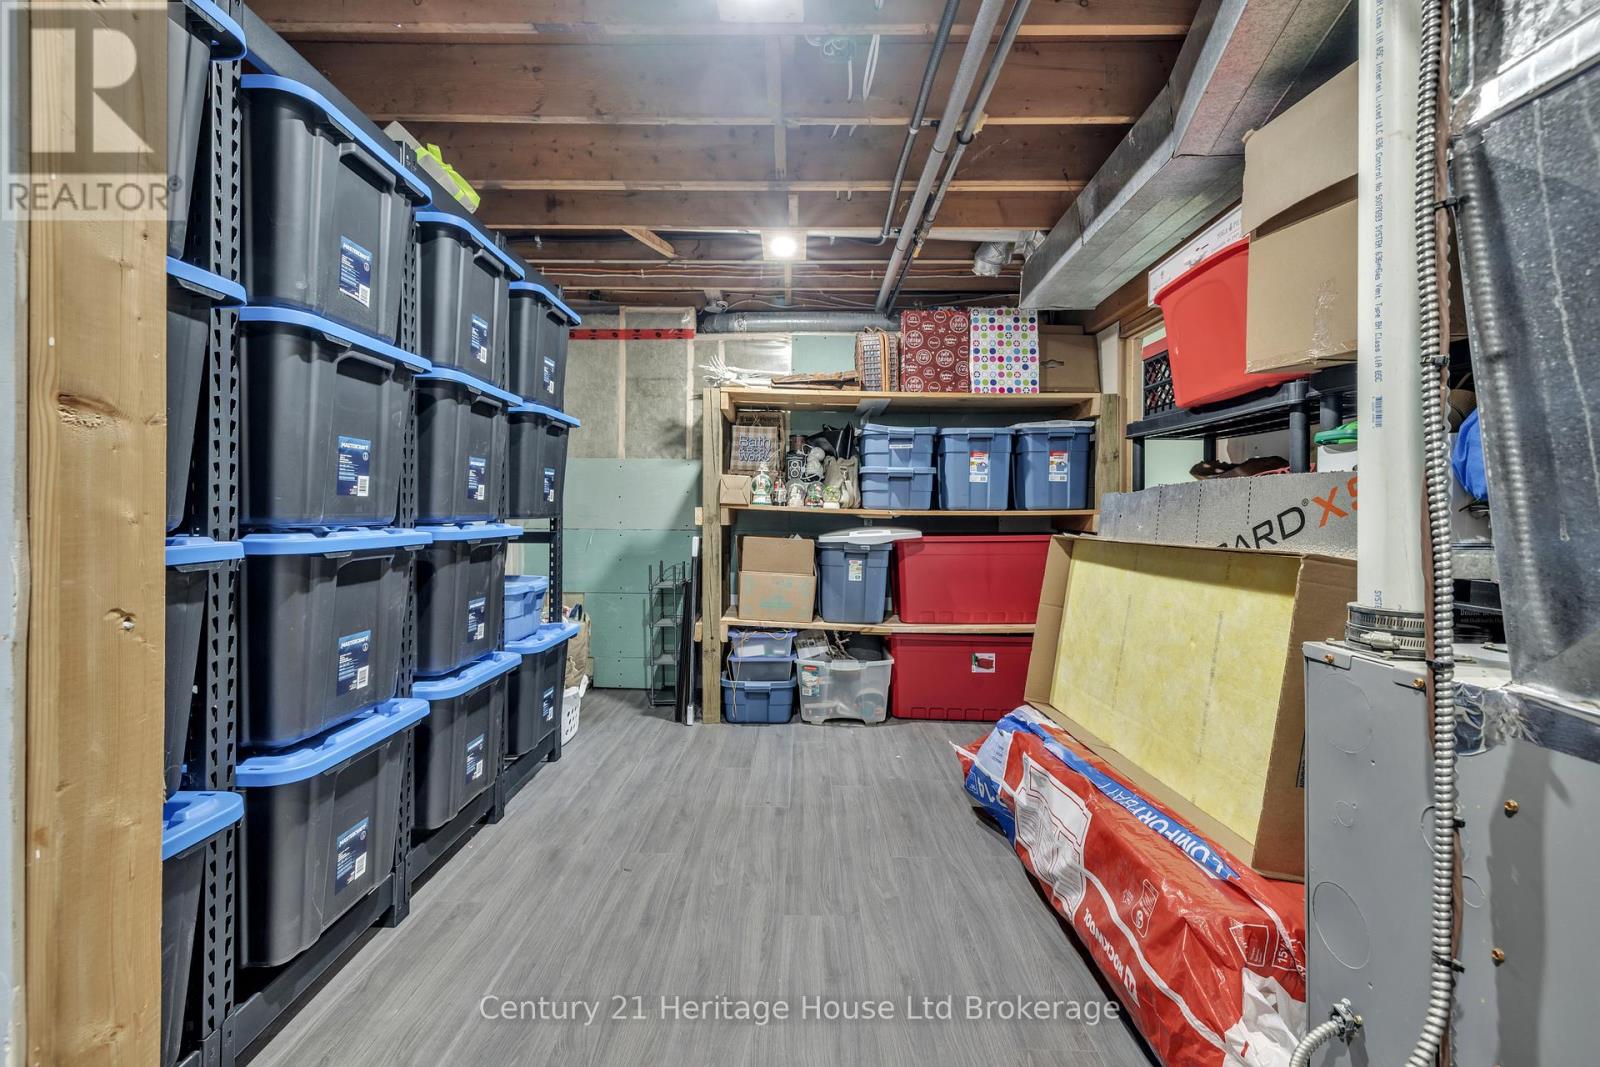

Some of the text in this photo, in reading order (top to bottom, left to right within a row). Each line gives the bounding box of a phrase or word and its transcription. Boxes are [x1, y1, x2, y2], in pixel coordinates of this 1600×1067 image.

[1375, 224, 1383, 249] SYSTEM
[1375, 283, 1383, 299] Vent
[1374, 302, 1383, 318] Type
[1375, 332, 1383, 352] Class
